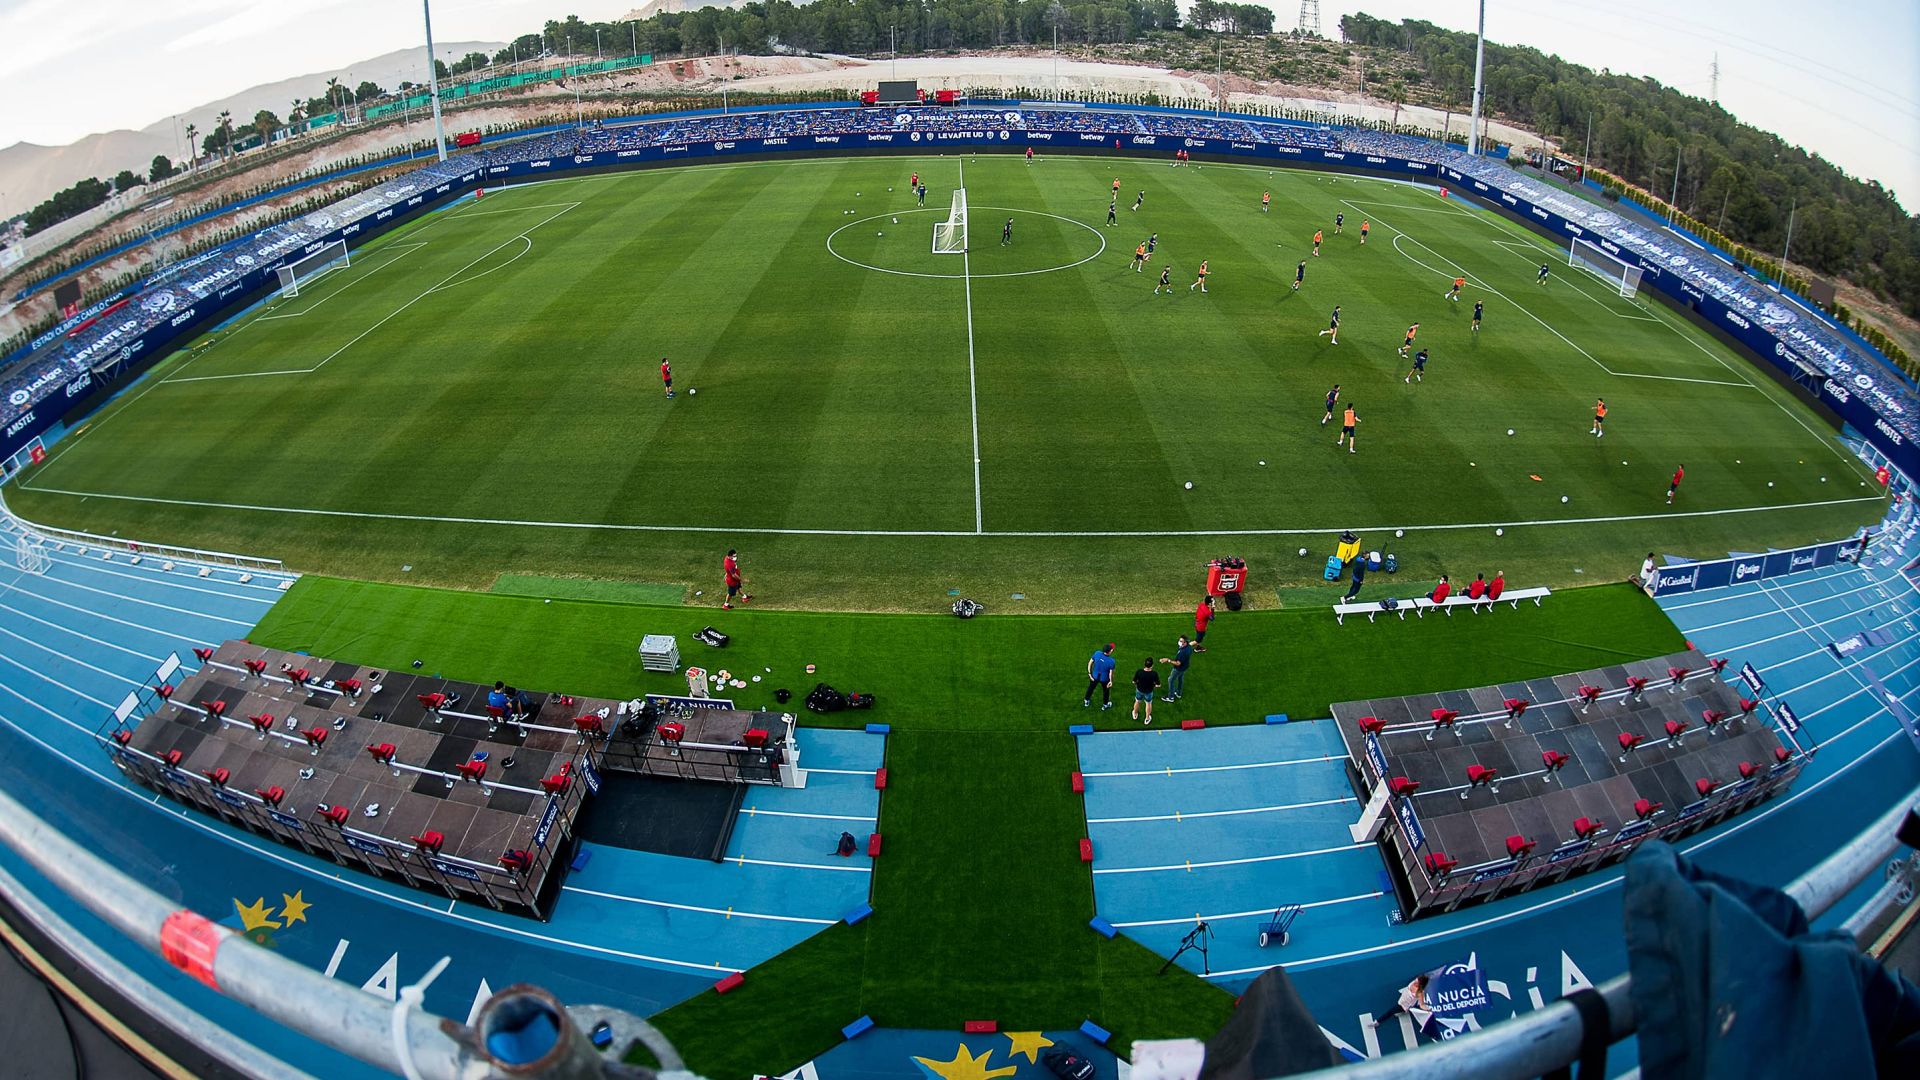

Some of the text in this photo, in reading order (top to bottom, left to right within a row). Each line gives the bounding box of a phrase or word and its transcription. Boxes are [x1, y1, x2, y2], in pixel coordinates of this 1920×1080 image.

[868, 134, 893, 142] betway
[1081, 134, 1105, 142] betway
[188, 268, 234, 292] ORGULL
[1688, 265, 1757, 309] VALENCIANS
[32, 333, 55, 350] ESTADI
[70, 329, 117, 363] LEVANTE
[118, 320, 137, 333] UD
[1789, 327, 1838, 362] LEVANTE
[7, 411, 36, 438] AMSTEL
[1443, 1003, 1456, 1011] DEL
[1456, 996, 1486, 1008] DEPORTE
